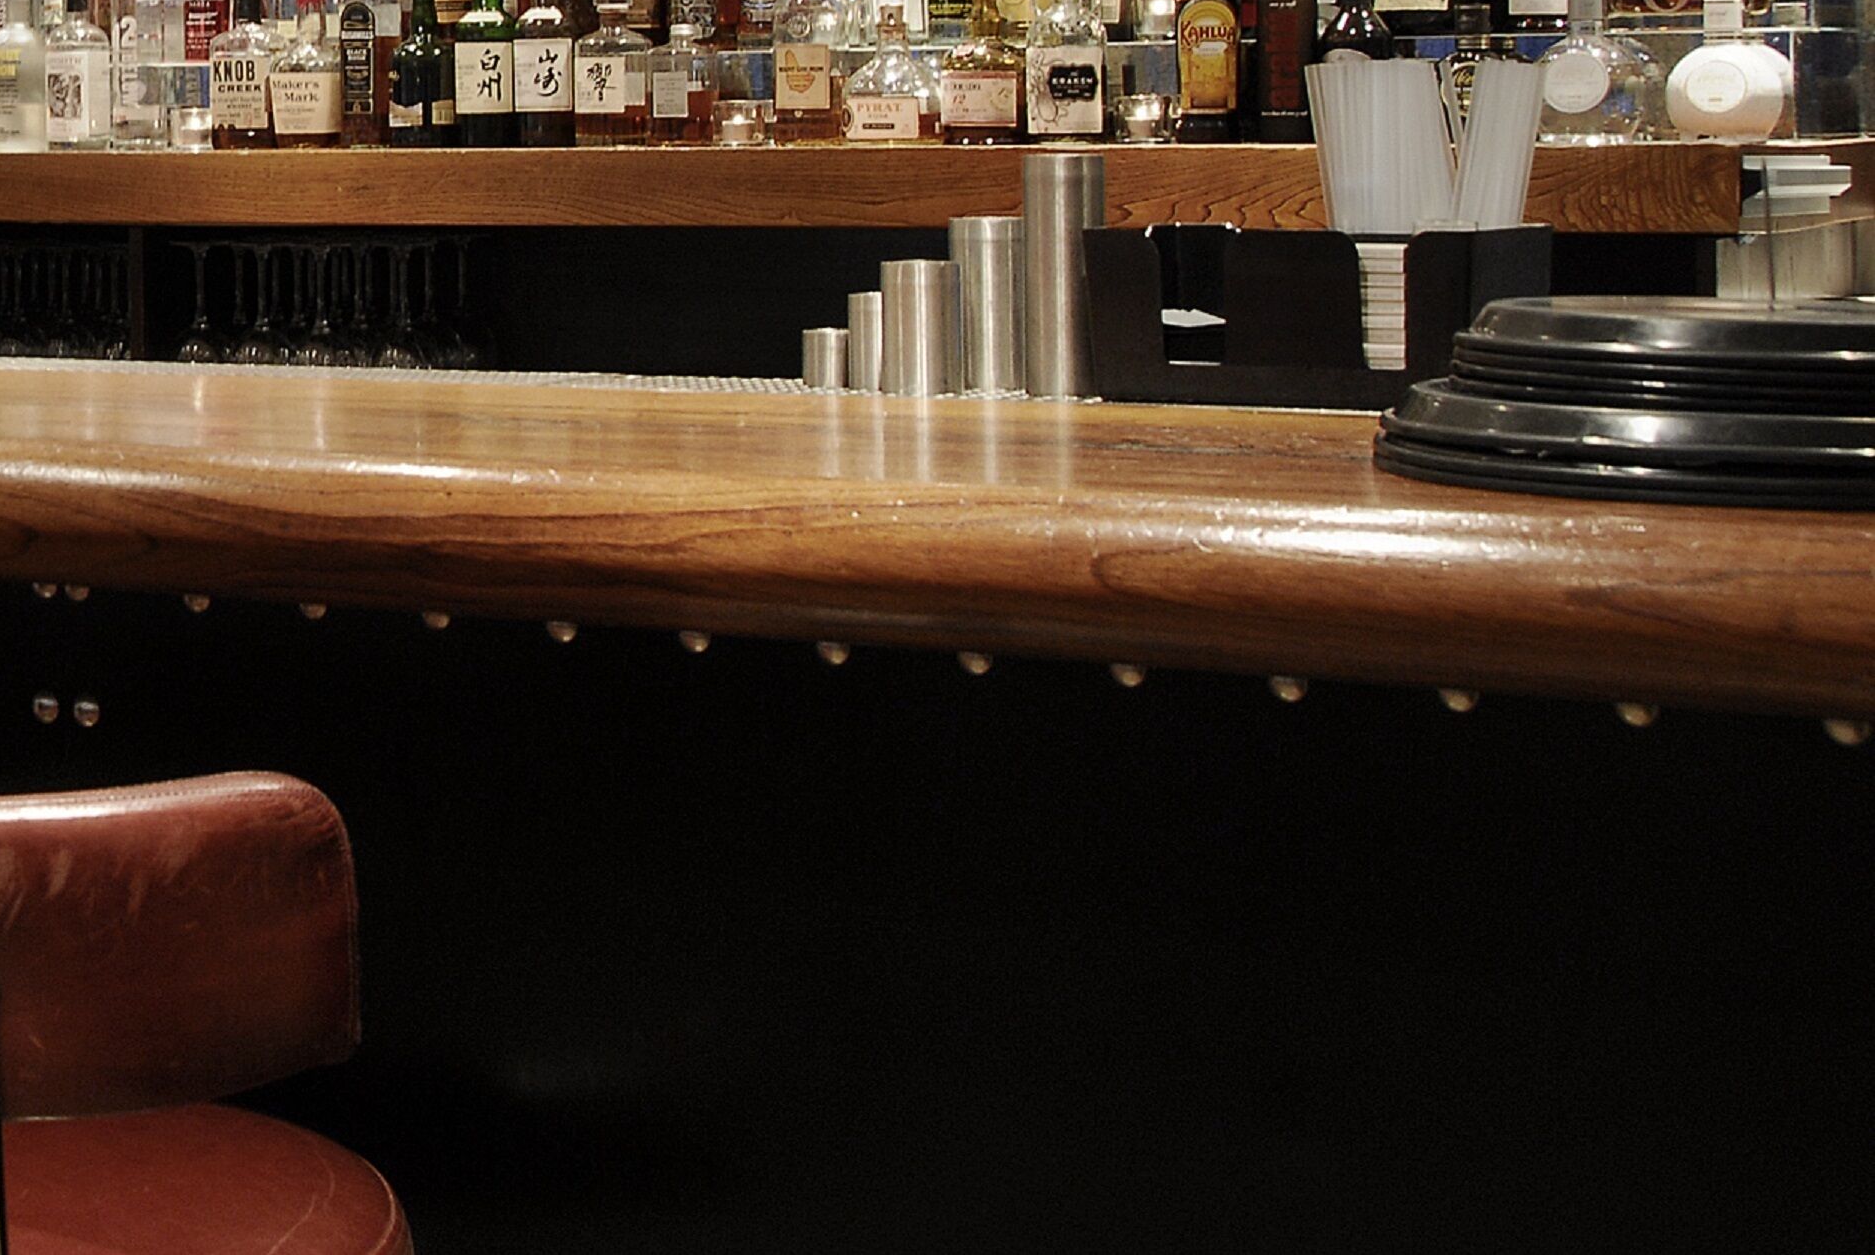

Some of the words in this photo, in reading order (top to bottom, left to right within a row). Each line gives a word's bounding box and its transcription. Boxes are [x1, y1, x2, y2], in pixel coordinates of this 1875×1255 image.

[213, 60, 256, 82] KNOB
[476, 48, 502, 103] 白州
[272, 80, 320, 91] Maker's
[1051, 77, 1094, 85] KRAKEN
[217, 84, 262, 93] CREEK
[284, 92, 321, 103] Mark
[951, 94, 967, 105] 12
